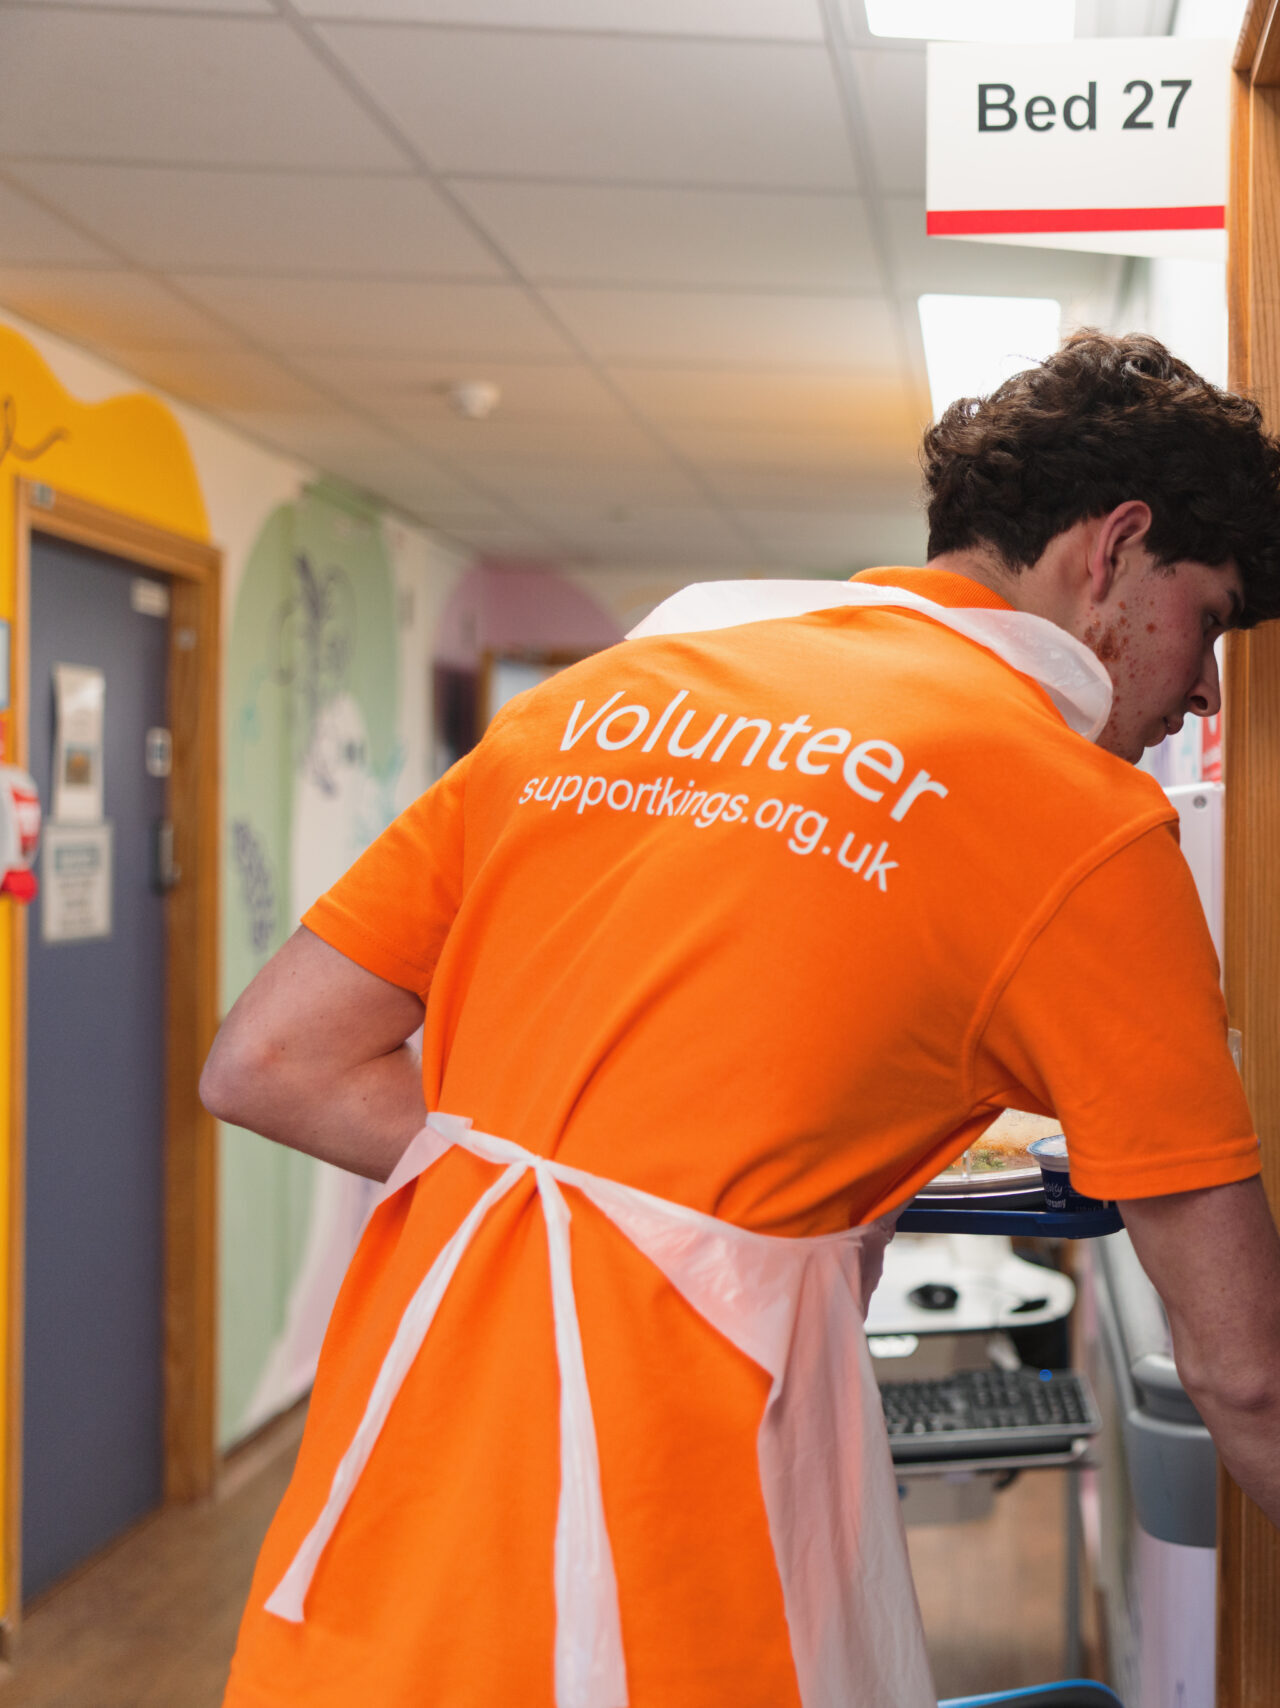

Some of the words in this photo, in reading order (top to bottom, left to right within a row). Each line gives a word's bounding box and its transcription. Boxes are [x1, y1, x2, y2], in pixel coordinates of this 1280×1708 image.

[977, 81, 1098, 133] Bed
[1122, 79, 1193, 131] 27
[558, 688, 950, 823] Volunteer
[517, 775, 900, 892] supportkings.org.uk
